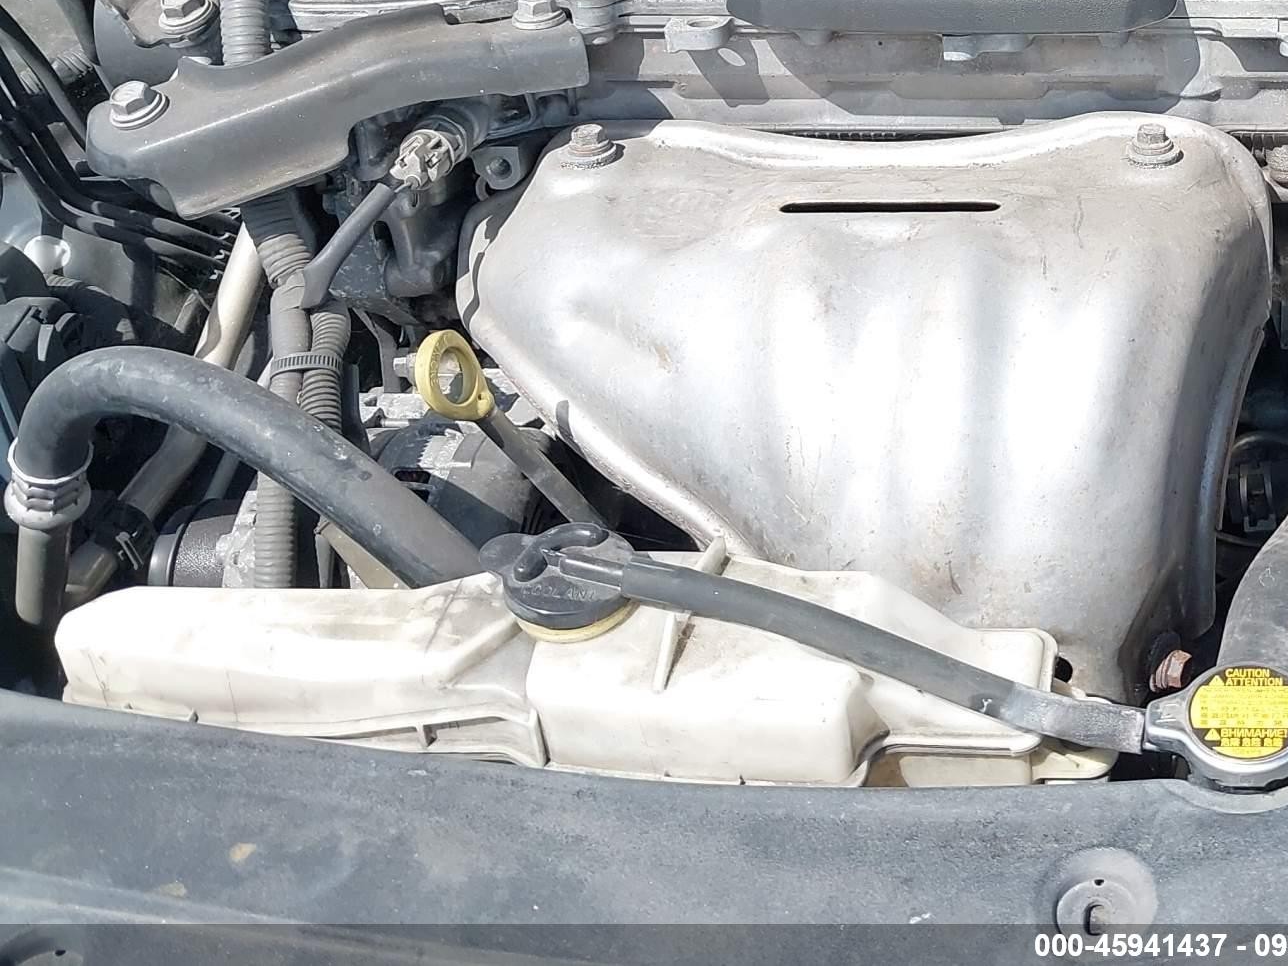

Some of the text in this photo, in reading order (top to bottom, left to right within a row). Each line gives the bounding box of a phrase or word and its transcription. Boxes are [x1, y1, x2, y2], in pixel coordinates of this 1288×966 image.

[1225, 668, 1270, 678] CAUTION
[1225, 677, 1283, 686] ATTENTION
[1220, 728, 1288, 738] ВНИМАНИЕ!
